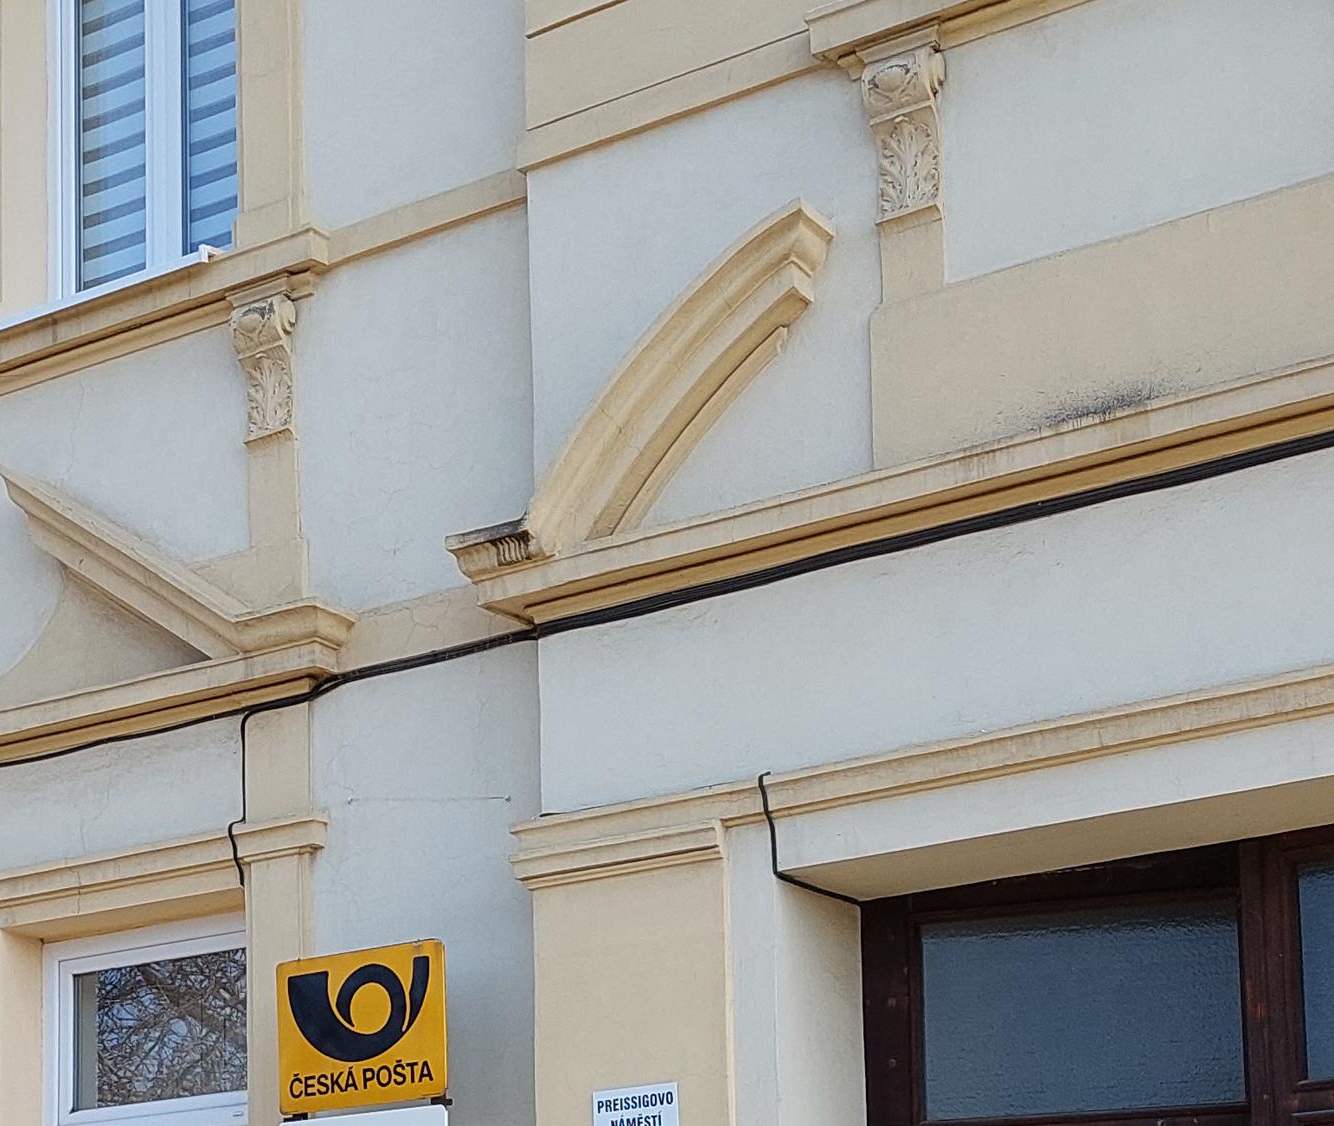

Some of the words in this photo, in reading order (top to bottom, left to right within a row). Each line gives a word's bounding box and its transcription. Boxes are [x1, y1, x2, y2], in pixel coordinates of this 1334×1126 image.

[289, 1066, 358, 1099] ČESKÁ
[363, 1059, 434, 1089] POŠTA
[597, 1091, 674, 1114] PREISSIGOVO
